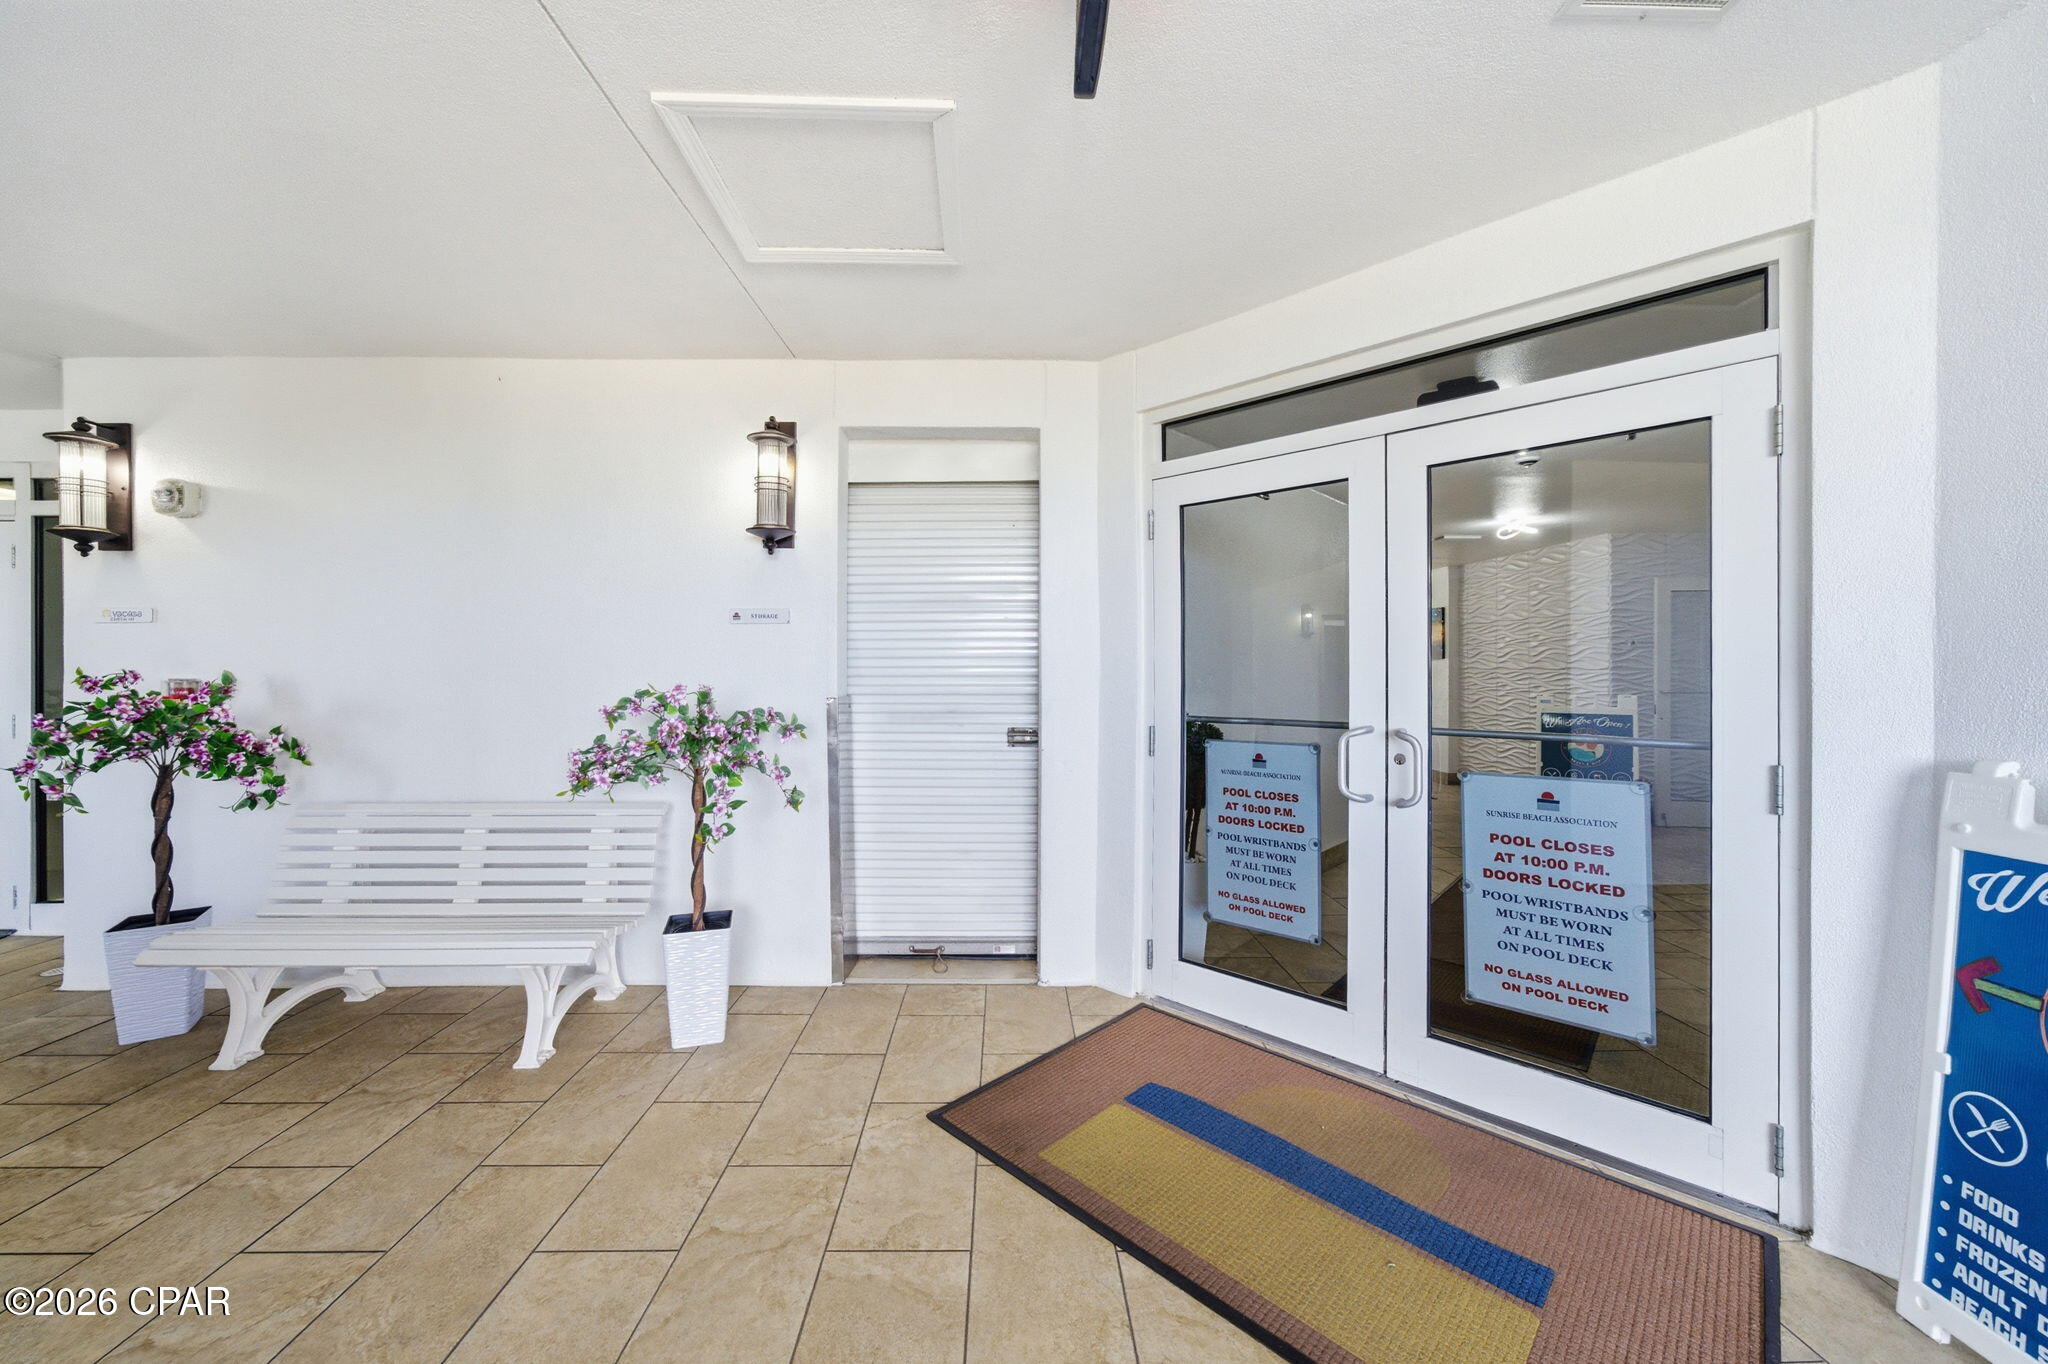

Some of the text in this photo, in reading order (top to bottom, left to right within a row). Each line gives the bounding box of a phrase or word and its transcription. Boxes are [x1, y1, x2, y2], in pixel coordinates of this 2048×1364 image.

[1223, 787, 1299, 803] POOL CLOSES
[1242, 804, 1270, 814] 10:00
[1275, 807, 1295, 817] P.M.
[1486, 810, 1617, 828] SUNRISE BEACH ASSOCIATION
[1218, 816, 1304, 833] DOORS LOCKED
[1217, 832, 1306, 851] POOL WRISTBANDS
[1489, 833, 1614, 857] POOL CLOSES
[1226, 847, 1296, 863] MUST BE WORN
[1494, 852, 1610, 875] AT 10:00 P.M.
[1226, 872, 1296, 890] ON POOL DECK
[1243, 862, 1259, 871] ALL
[1262, 865, 1292, 876] TIMES
[1483, 868, 1625, 897] DOORS LOCKED
[1229, 903, 1293, 923] ON POOL DECK
[1233, 893, 1259, 904] GLASS
[1263, 899, 1305, 913] ALLOWED
[1482, 890, 1629, 920] POOL WRISTBANDS
[1497, 908, 1612, 936] MUST BE WORN
[1503, 927, 1604, 951] AT ALL TIMES
[1498, 940, 1613, 971] ON POOL DECK
[1485, 964, 1629, 1002] NO GLASS ALLOWED
[1502, 982, 1609, 1013] ON POOL DECK
[1961, 1181, 2019, 1228] FOOD
[1958, 1207, 2046, 1273] DRINKS
[1955, 1233, 2048, 1305] FROZEN
[1952, 1262, 2027, 1319] ADULT
[1951, 1287, 2027, 1353] BEACH
